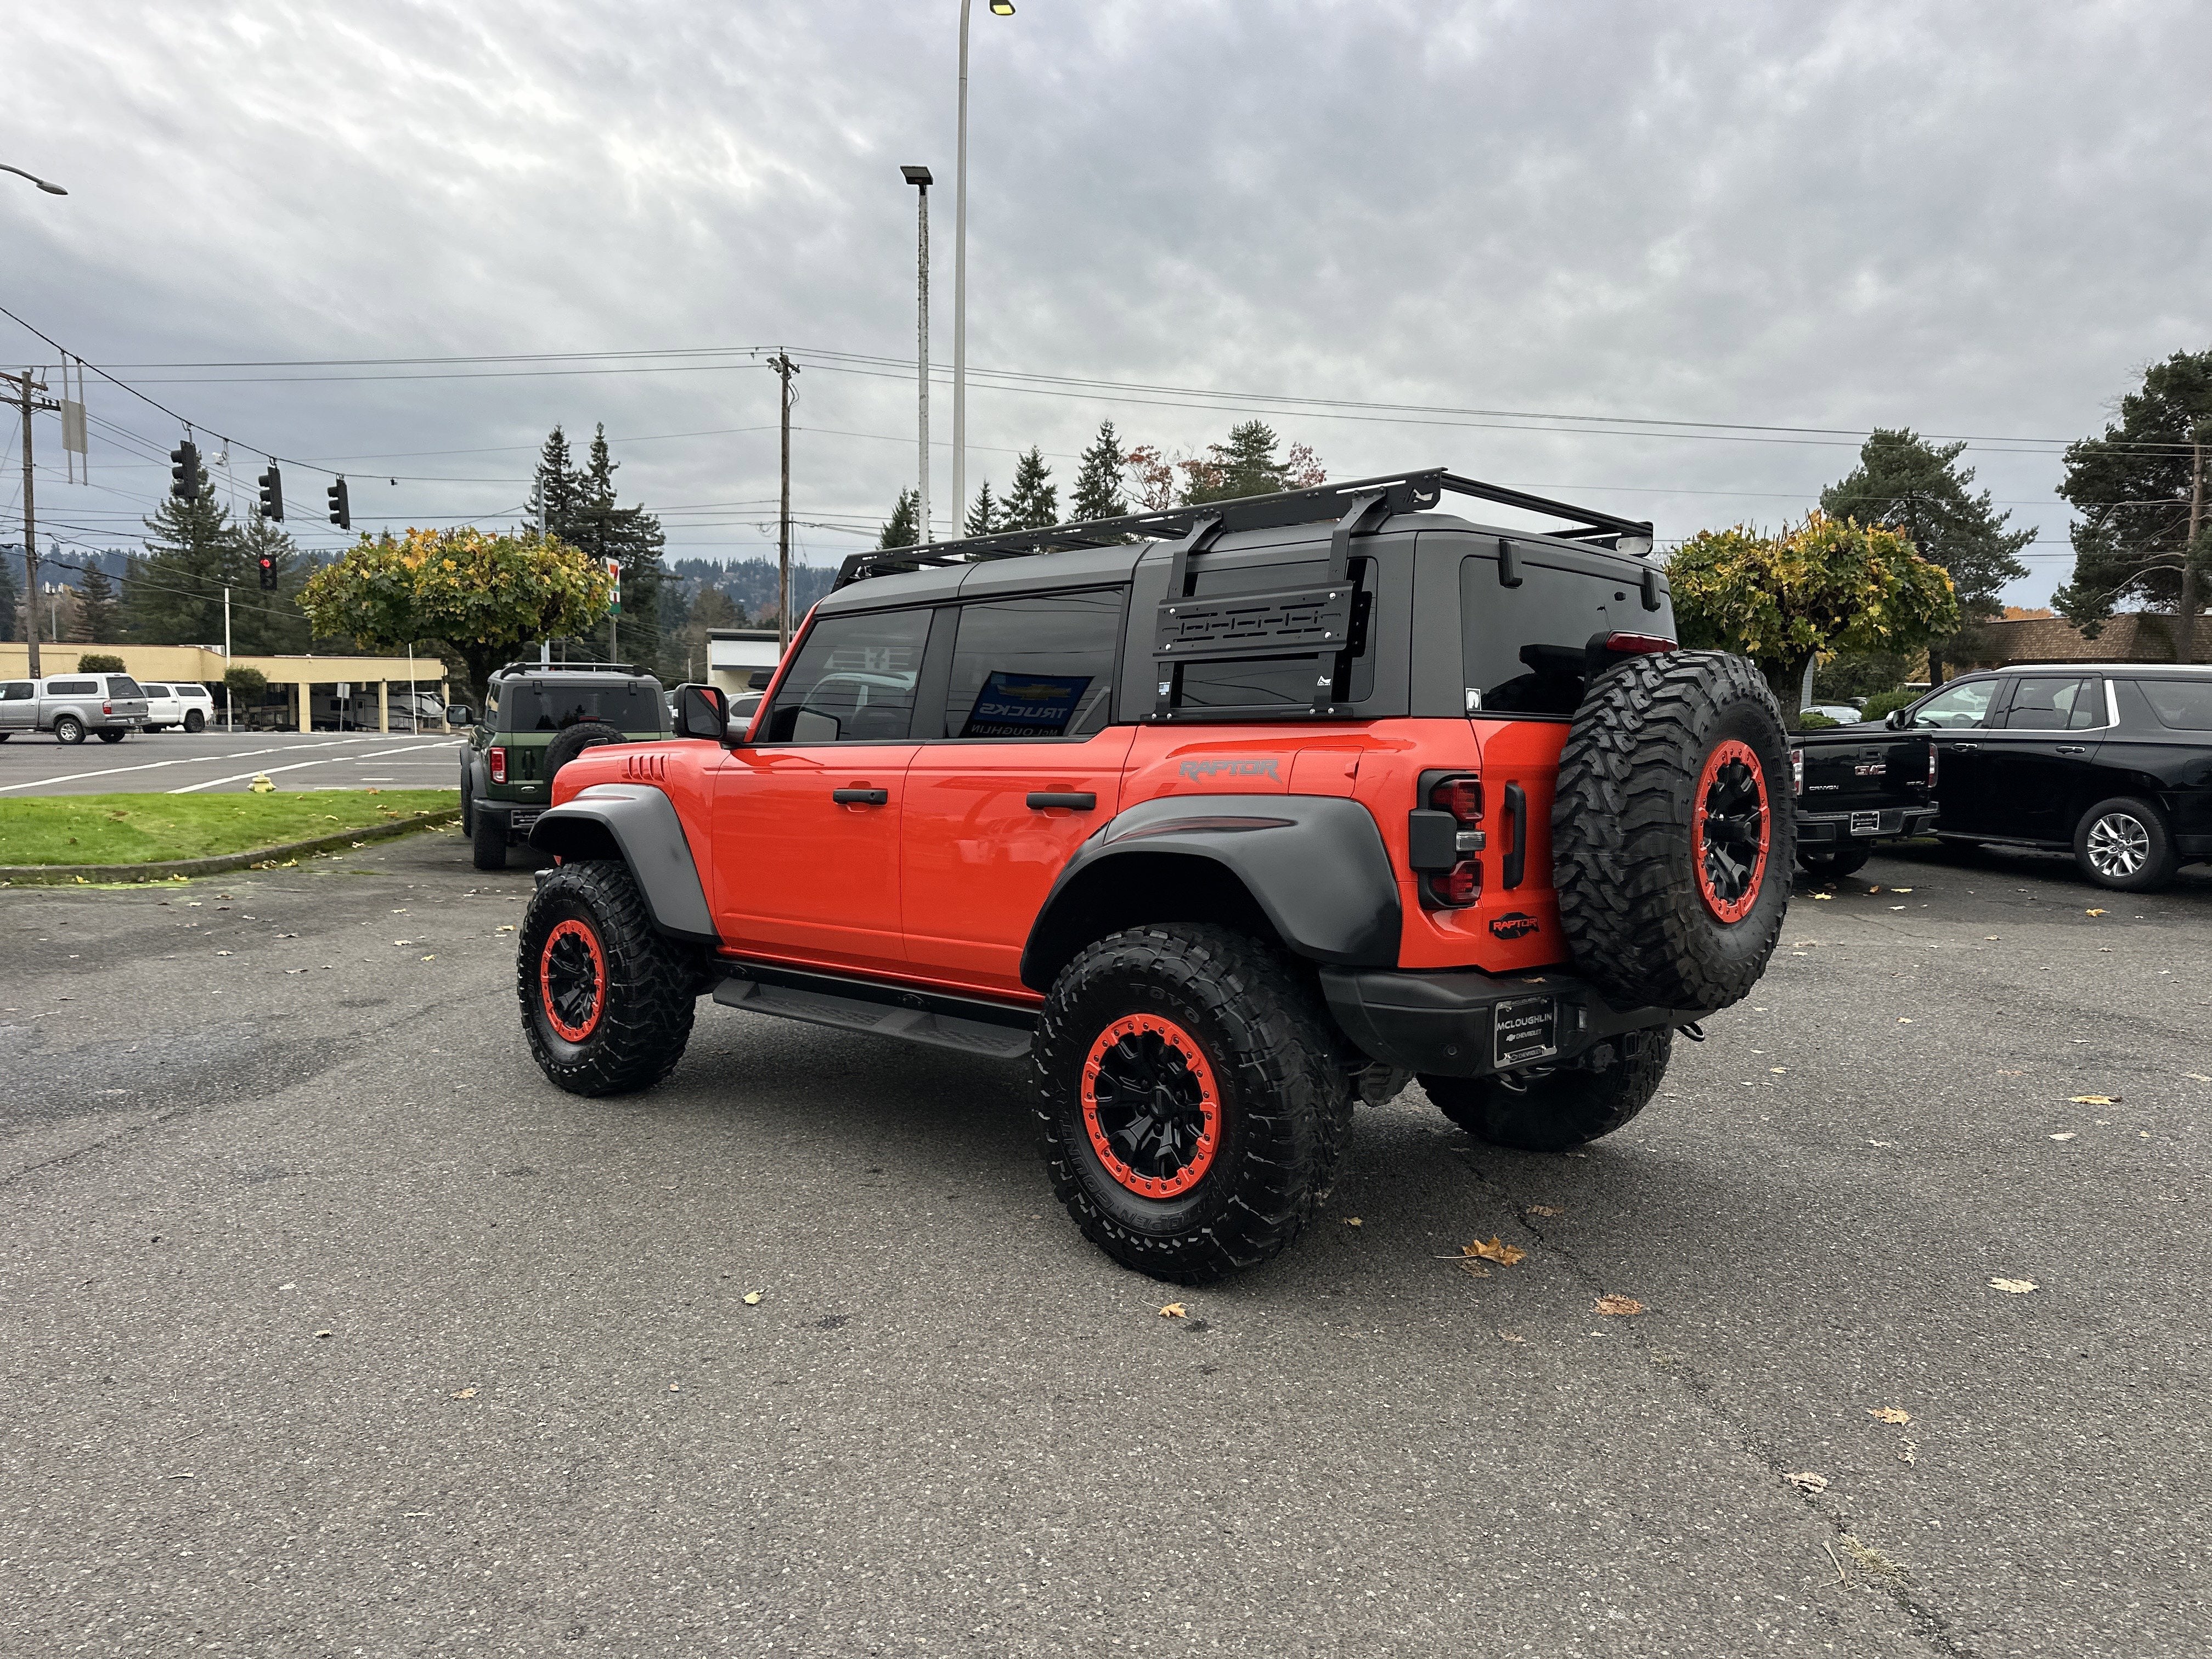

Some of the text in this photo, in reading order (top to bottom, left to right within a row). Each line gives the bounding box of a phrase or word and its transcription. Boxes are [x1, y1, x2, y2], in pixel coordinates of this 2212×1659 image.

[1178, 759, 1284, 785] RAPTOR
[1855, 764, 1886, 776] GMC
[1493, 918, 1537, 932] RAPTOR
[1496, 1013, 1552, 1031] MCLOUGHLIN
[1516, 1029, 1542, 1039] CHEVROLET
